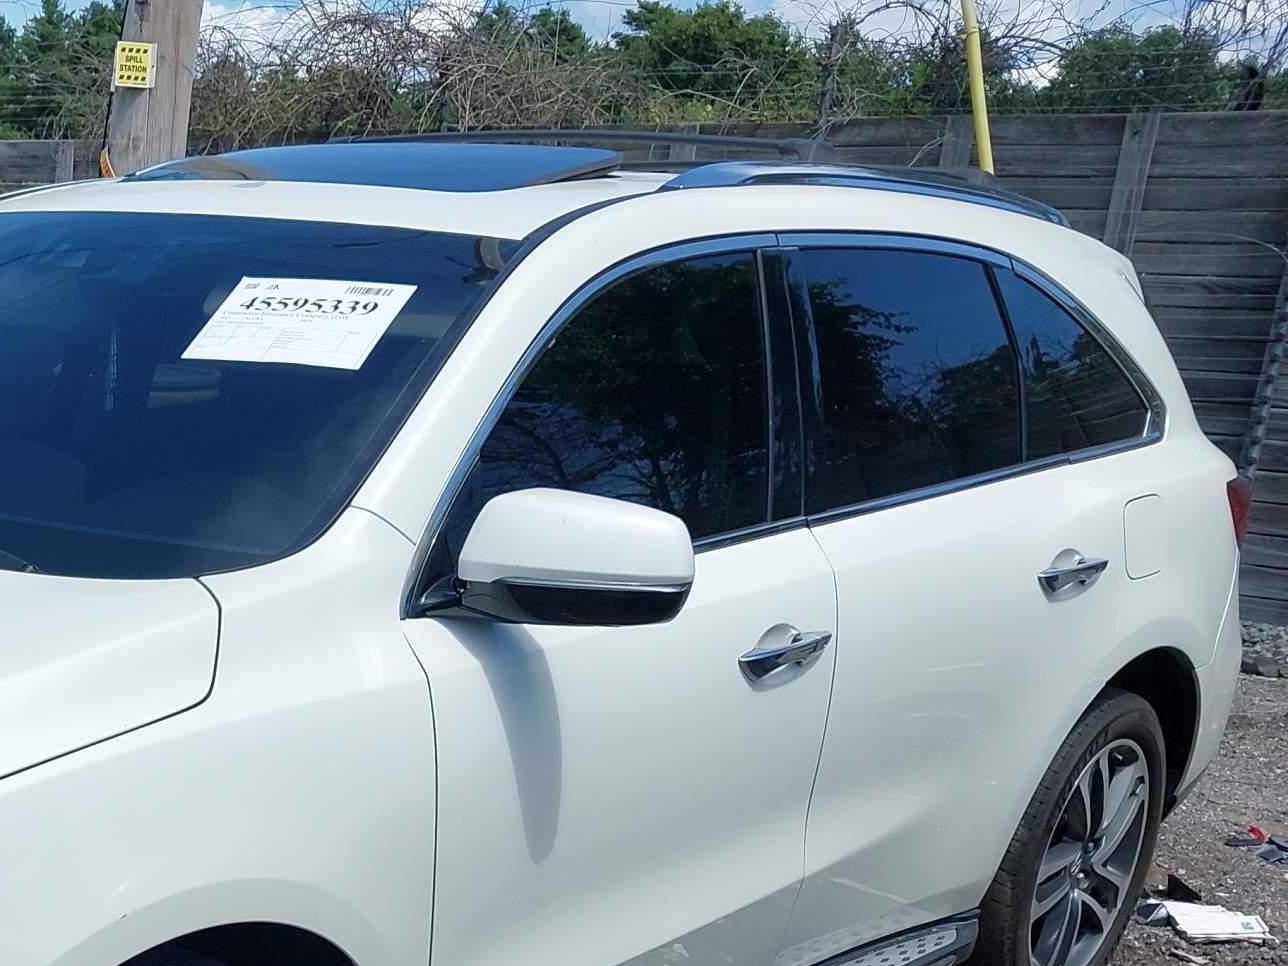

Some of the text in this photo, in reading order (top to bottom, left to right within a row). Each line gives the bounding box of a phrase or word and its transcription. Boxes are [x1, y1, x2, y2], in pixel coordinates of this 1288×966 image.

[125, 55, 143, 63] SPILL
[119, 64, 147, 73] STATION
[239, 297, 379, 315] 45595339
